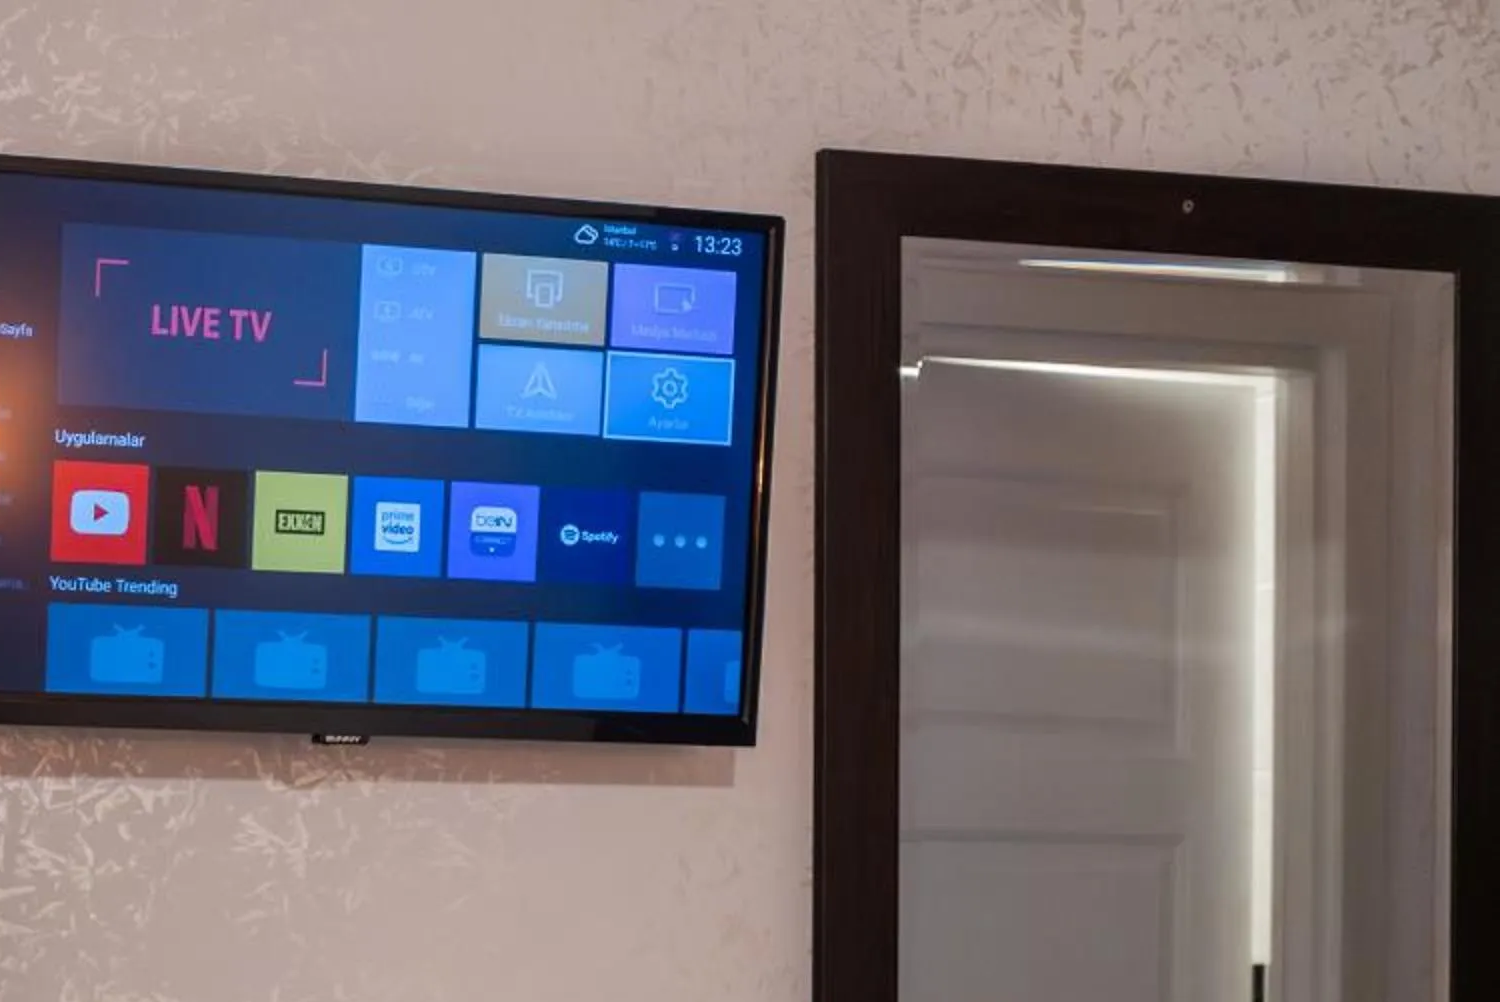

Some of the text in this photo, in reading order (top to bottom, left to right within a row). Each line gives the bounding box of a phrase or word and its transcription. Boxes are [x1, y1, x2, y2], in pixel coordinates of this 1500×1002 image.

[695, 235, 743, 257] 13:23
[0, 323, 34, 338] Sayfa
[150, 303, 272, 342] LIVE TV
[54, 429, 146, 449] Uygulamalar
[380, 511, 415, 523] prime
[380, 523, 415, 535] video
[581, 529, 621, 545] Spotify
[49, 575, 112, 594] YouTube
[115, 578, 179, 598] Trending
